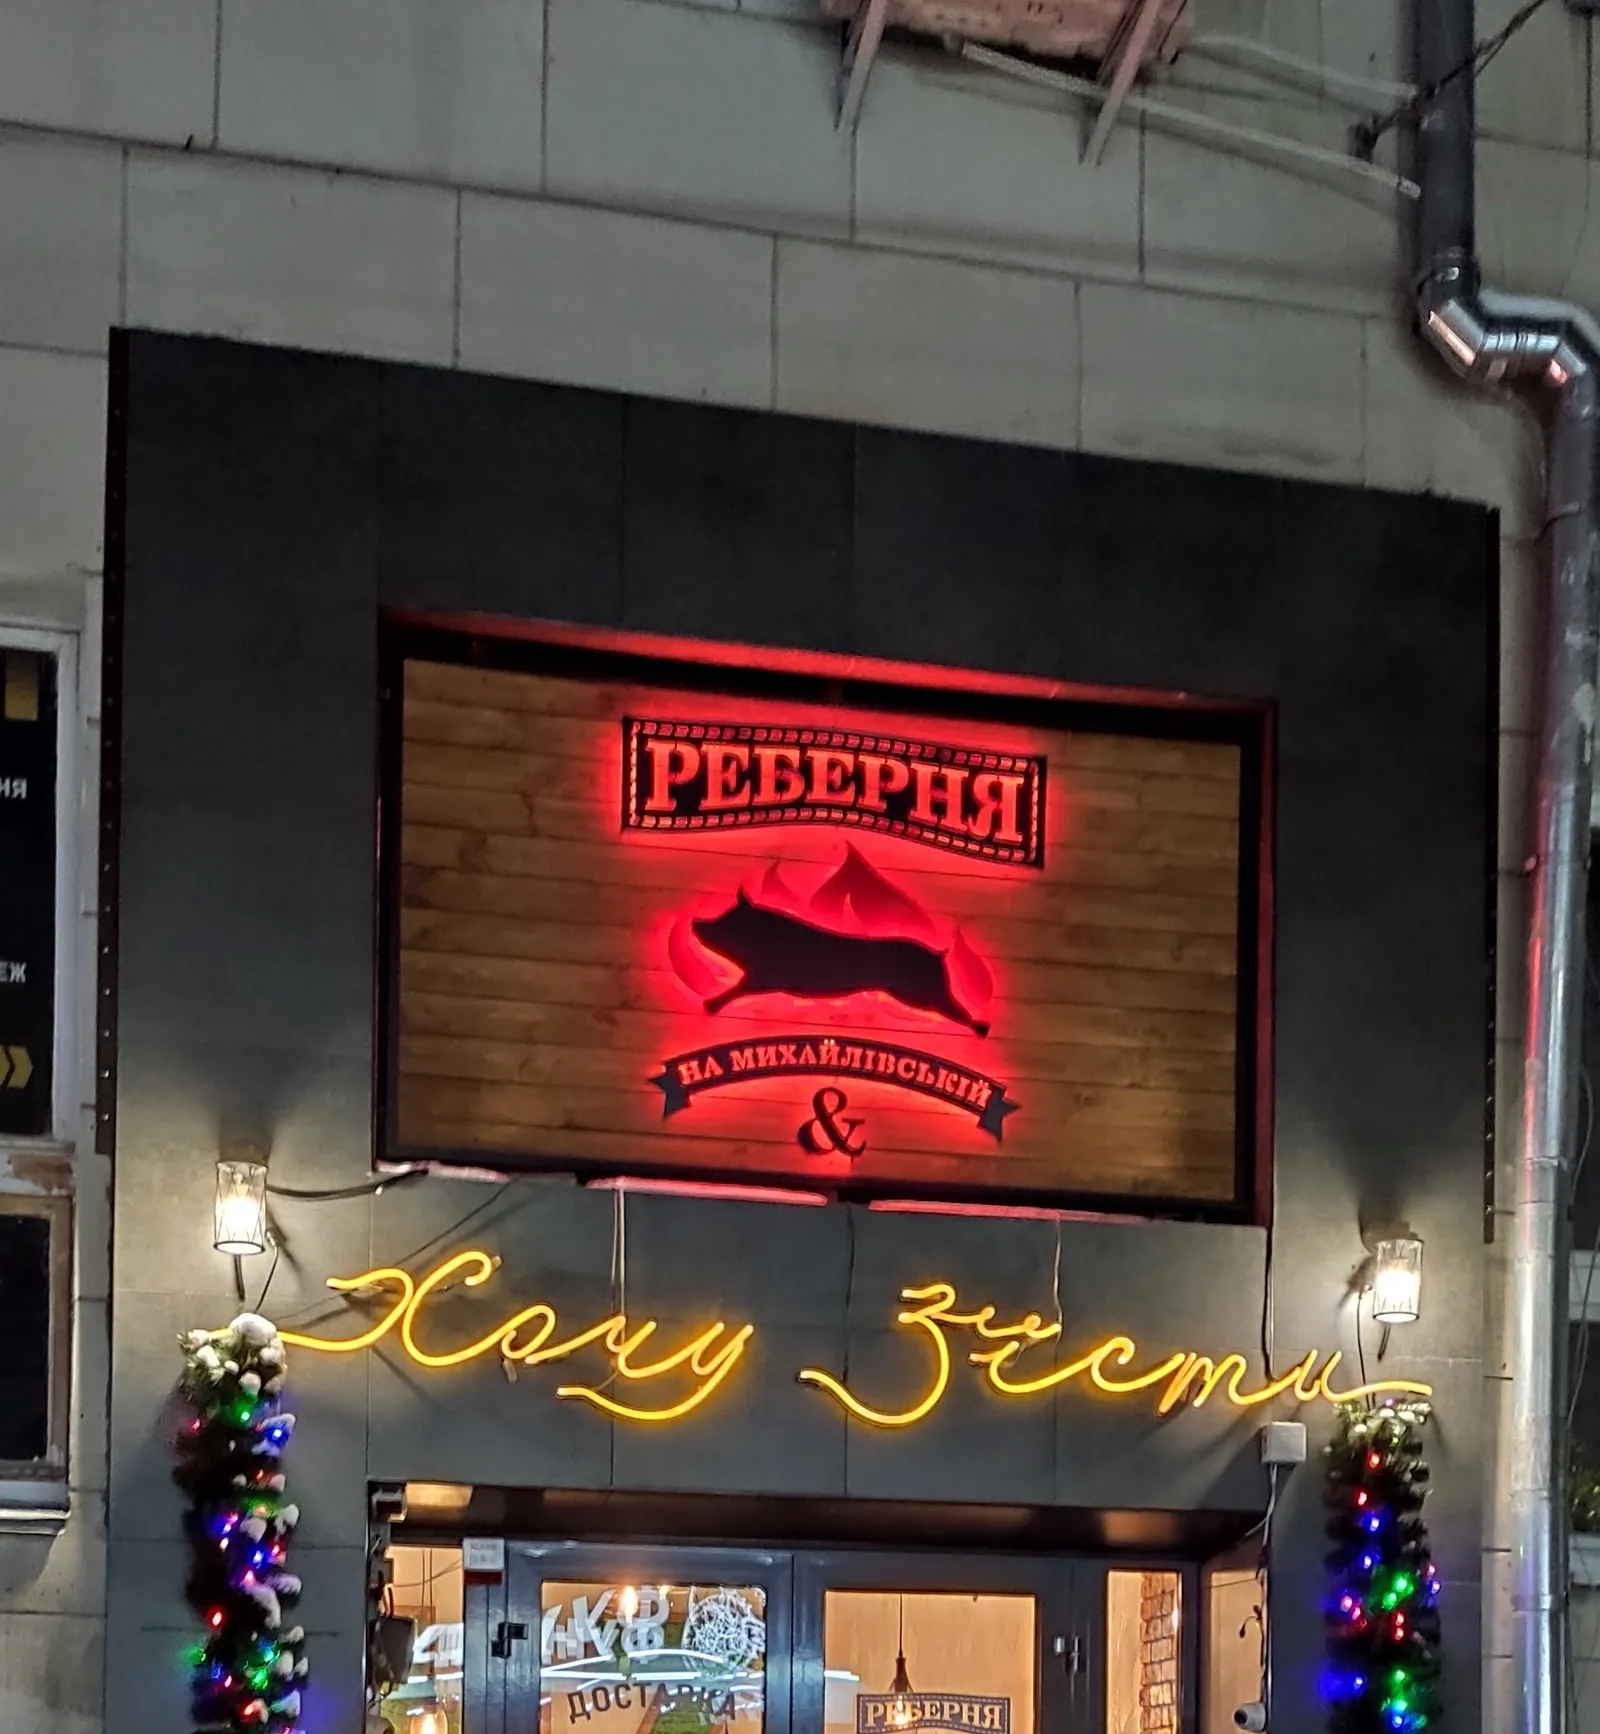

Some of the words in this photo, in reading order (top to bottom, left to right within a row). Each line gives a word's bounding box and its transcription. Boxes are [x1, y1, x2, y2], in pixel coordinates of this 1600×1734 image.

[645, 738, 1024, 847] РЕБЕРНЯ
[678, 1056, 724, 1087] НА
[730, 1038, 993, 1112] МИХАЙЛІВСЬКІЙ
[797, 1087, 867, 1157] &
[864, 1700, 1003, 1730] РЕБЕРНЯ
